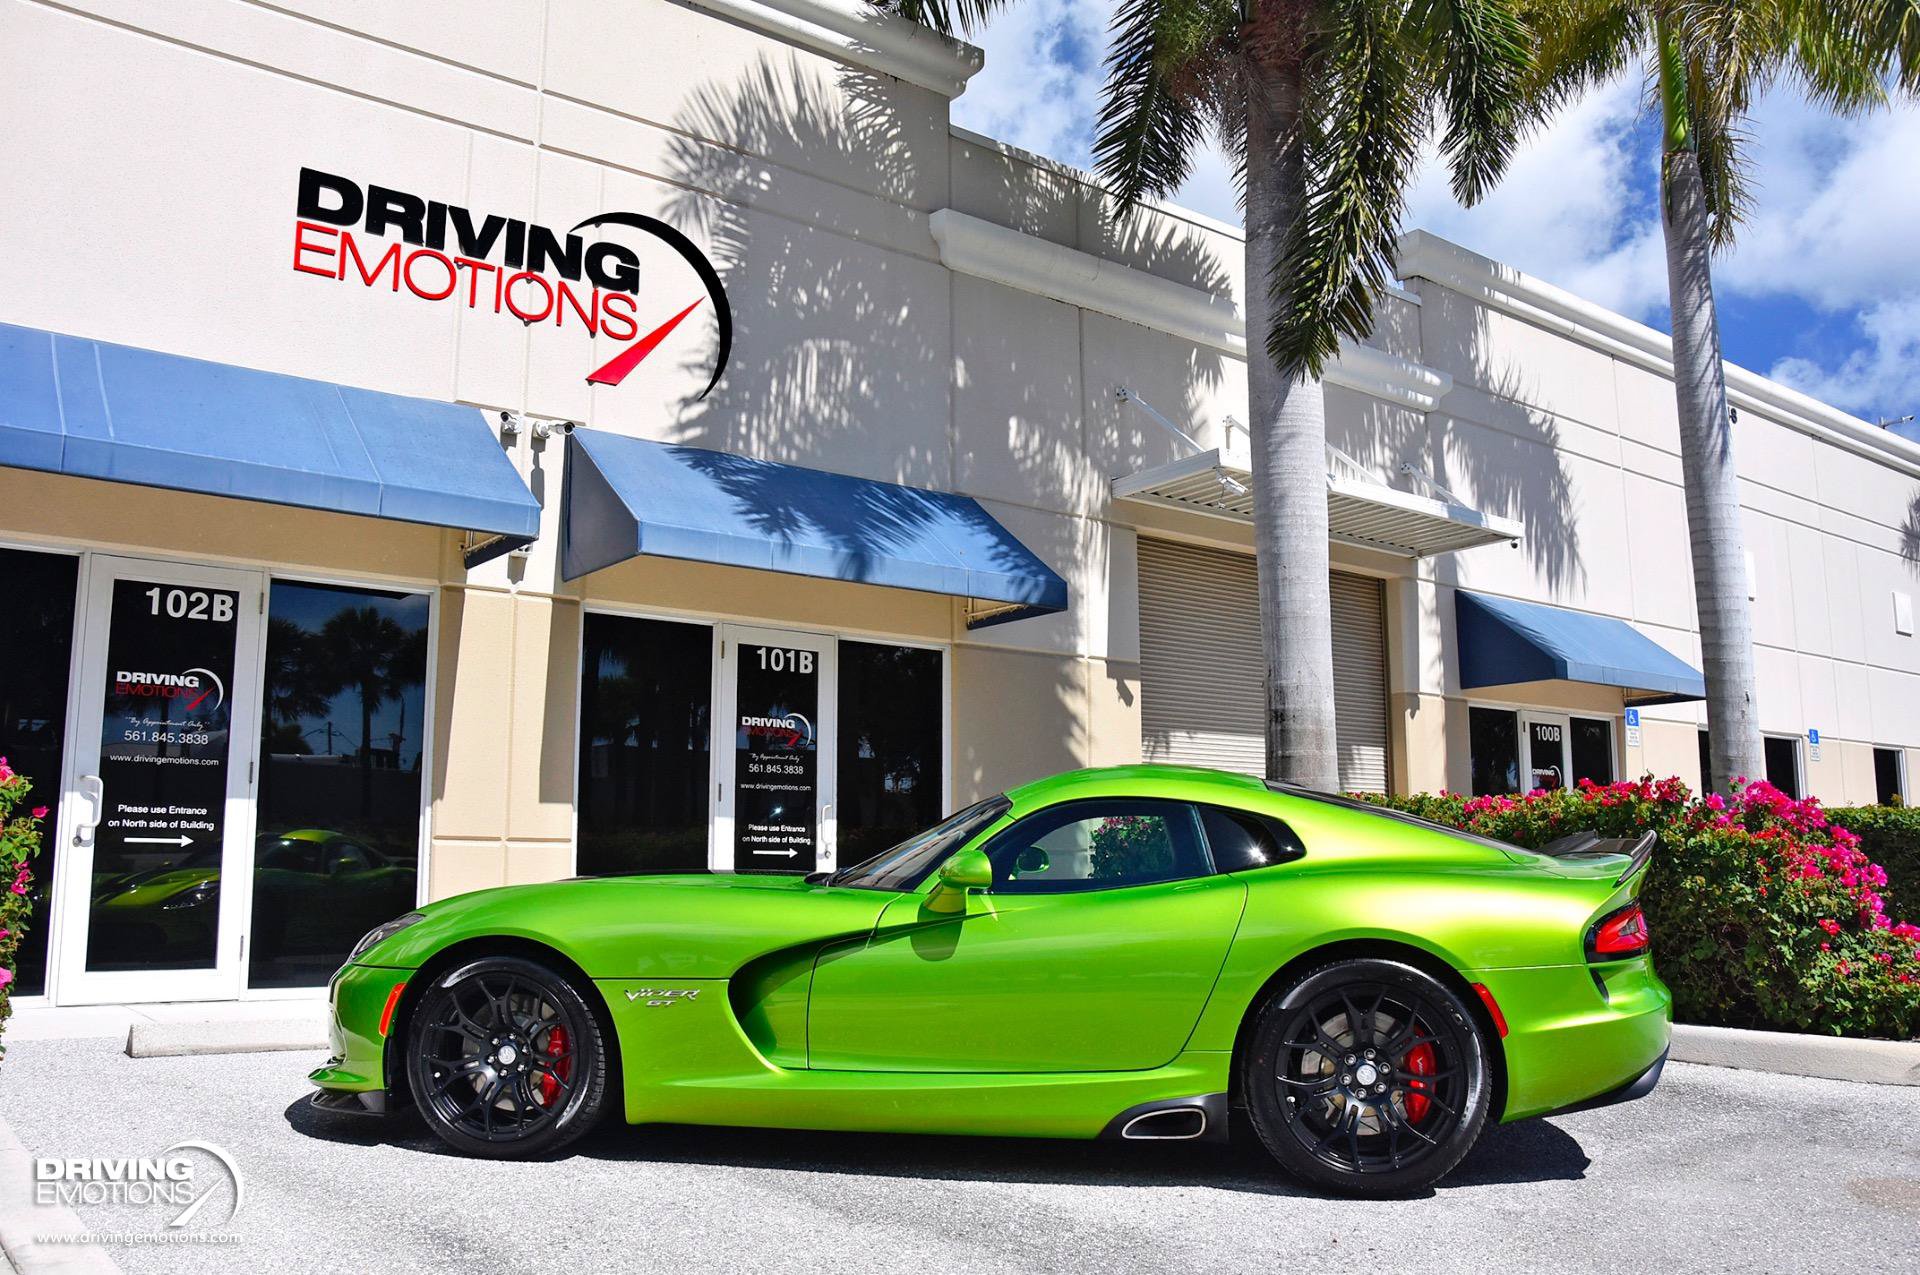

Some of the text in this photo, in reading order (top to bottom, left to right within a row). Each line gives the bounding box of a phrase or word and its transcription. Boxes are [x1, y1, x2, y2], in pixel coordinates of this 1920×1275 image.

[297, 167, 640, 294] DRIVING
[293, 220, 639, 341] EMOTIONS
[146, 587, 234, 622] 102B
[757, 647, 813, 674] 101B
[116, 671, 200, 688] DRIVING
[741, 716, 796, 729] DRIVING
[124, 731, 209, 745] 561.845.3838
[1536, 726, 1560, 742] 100B
[109, 754, 220, 766] www.drivingemotions.com
[748, 763, 804, 775] 561.845.3838
[1532, 768, 1555, 776] DRIVING
[740, 783, 812, 792] www.drivingemotions.com
[118, 804, 149, 814] Please
[168, 805, 208, 816] Entrance
[122, 819, 147, 828] North
[149, 820, 168, 829] side
[169, 820, 179, 829] of
[180, 820, 215, 832] Building
[748, 823, 768, 832] Please
[781, 824, 806, 833] Entrance
[751, 835, 768, 843] North
[768, 835, 781, 843] side
[788, 836, 812, 846] Building
[624, 989, 700, 1002] VIPER
